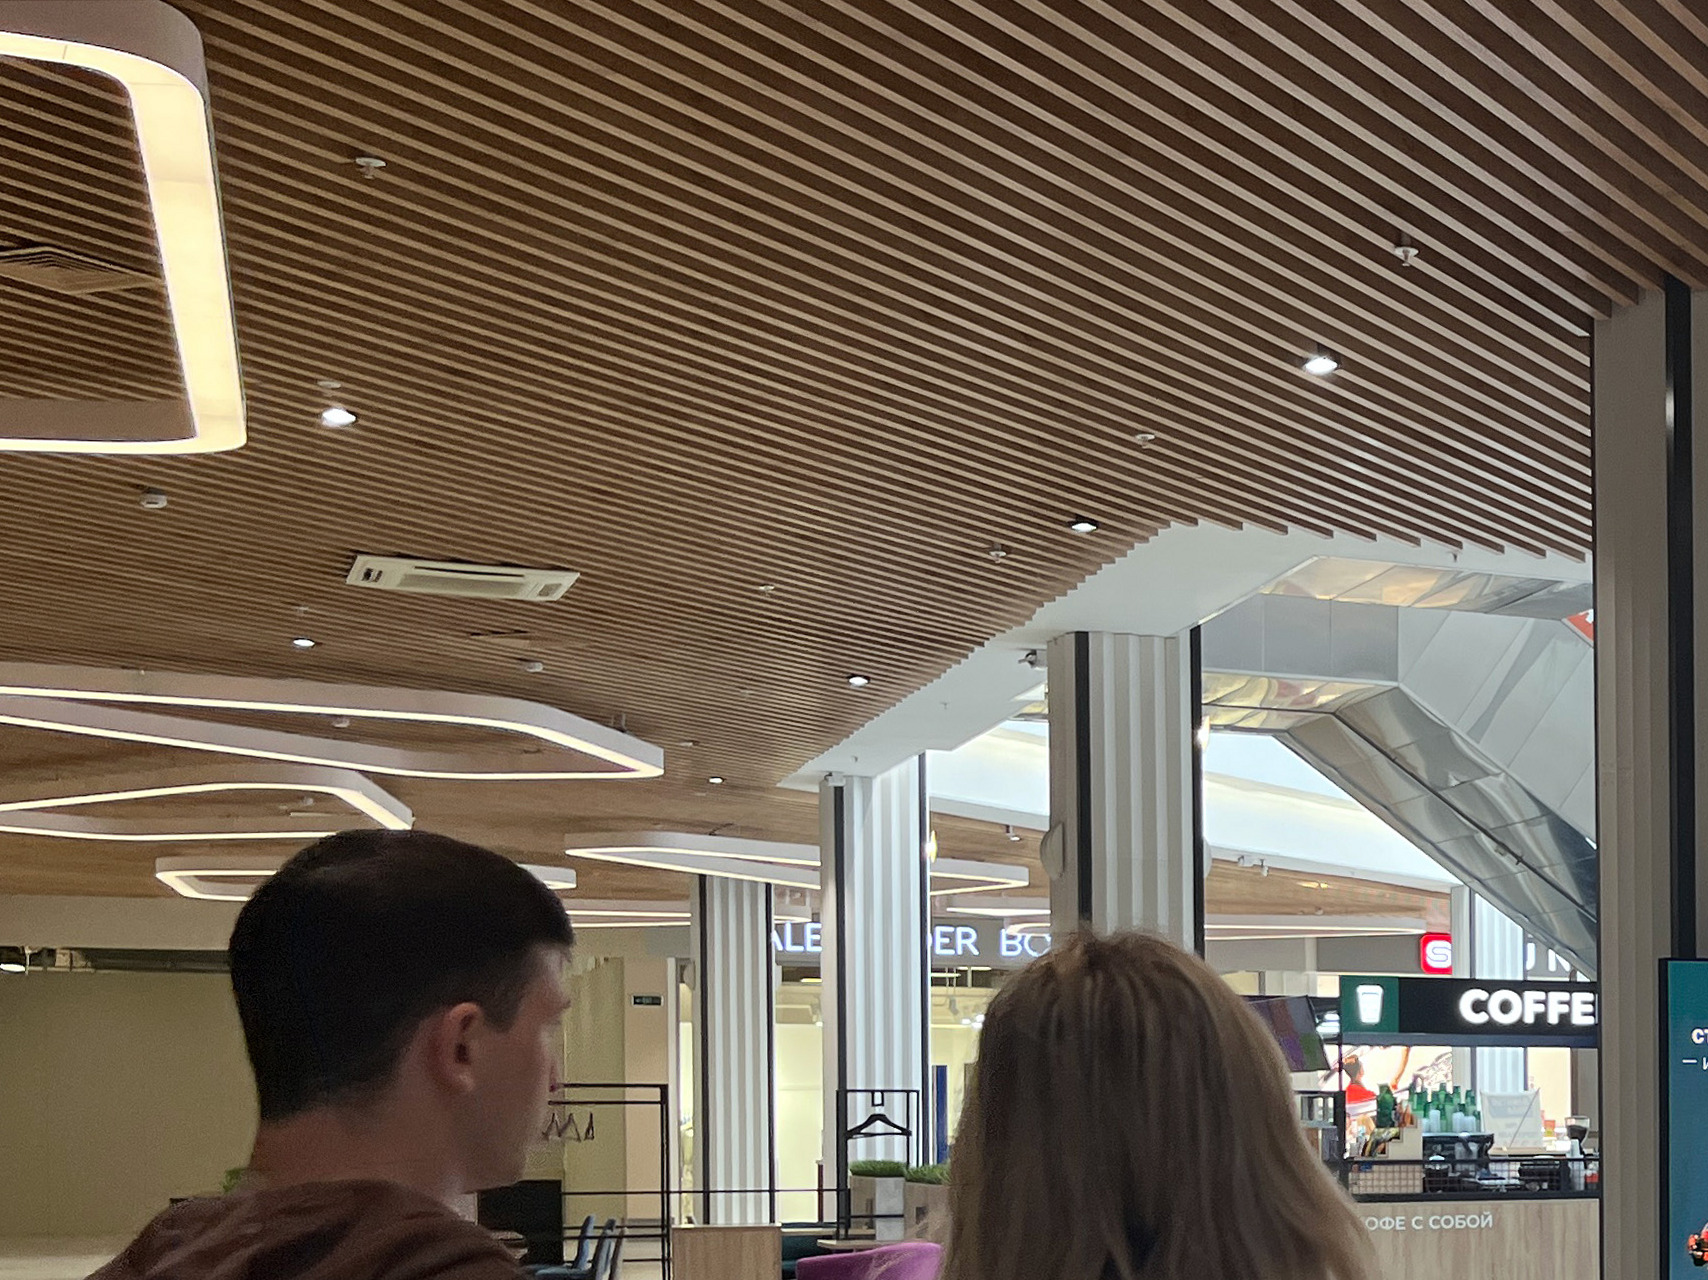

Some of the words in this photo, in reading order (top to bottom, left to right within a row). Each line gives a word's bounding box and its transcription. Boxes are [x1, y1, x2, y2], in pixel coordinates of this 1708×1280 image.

[1459, 988, 1598, 1025] COFFE
[1411, 1216, 1424, 1230] С
[1429, 1211, 1493, 1229] СОБОЙ
